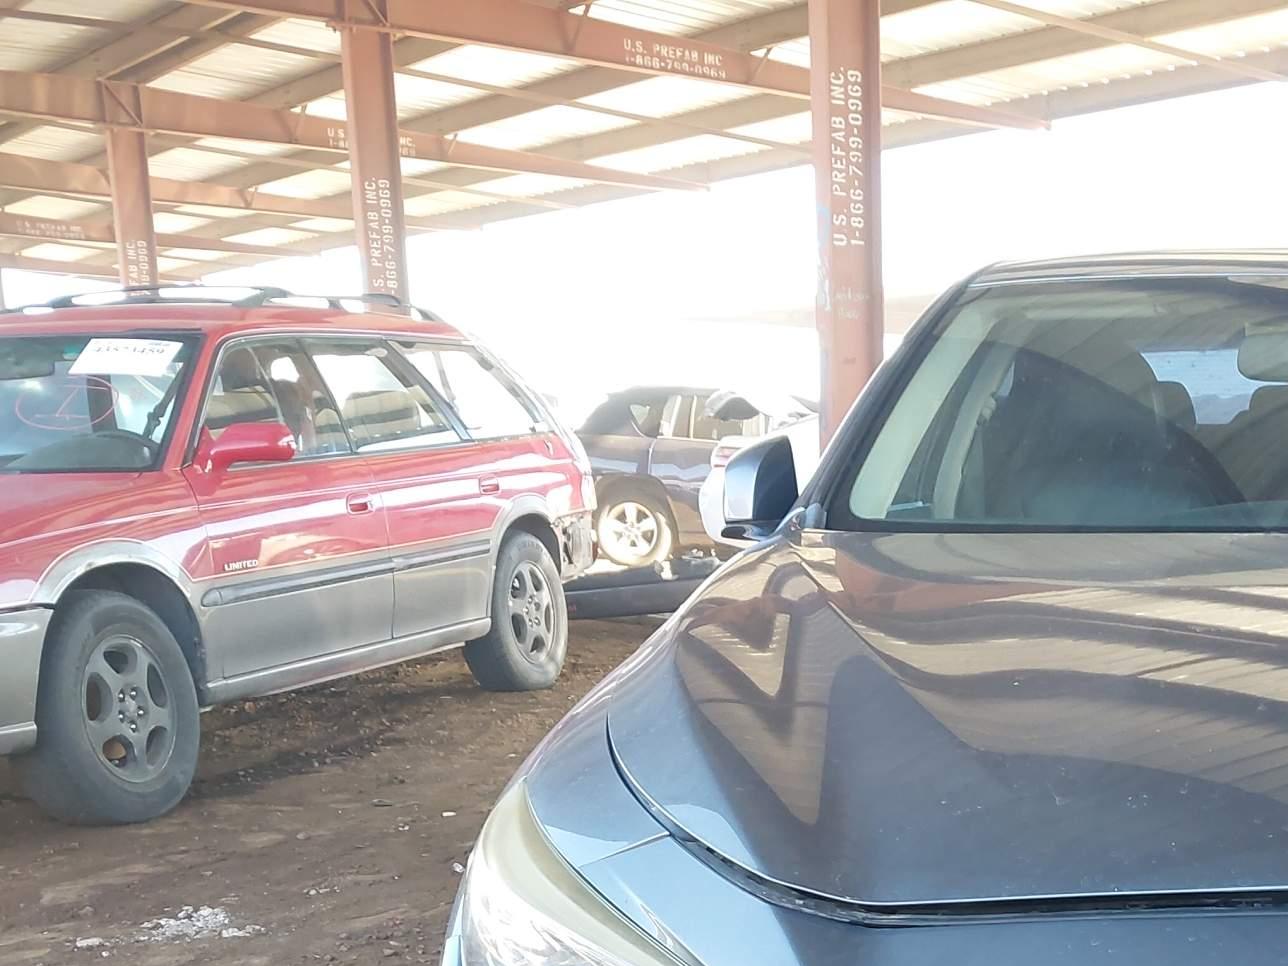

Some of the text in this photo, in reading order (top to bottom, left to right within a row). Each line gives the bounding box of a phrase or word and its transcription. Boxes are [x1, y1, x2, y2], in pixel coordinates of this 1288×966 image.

[623, 38, 647, 54] U.S.
[653, 43, 699, 62] PREFAB
[830, 66, 848, 247] U.S. PREFAB INC.
[847, 69, 865, 246] 1-866-799-0969
[365, 177, 377, 204] INC.
[368, 210, 383, 267] PREFAB
[224, 559, 258, 571] LIMITED
